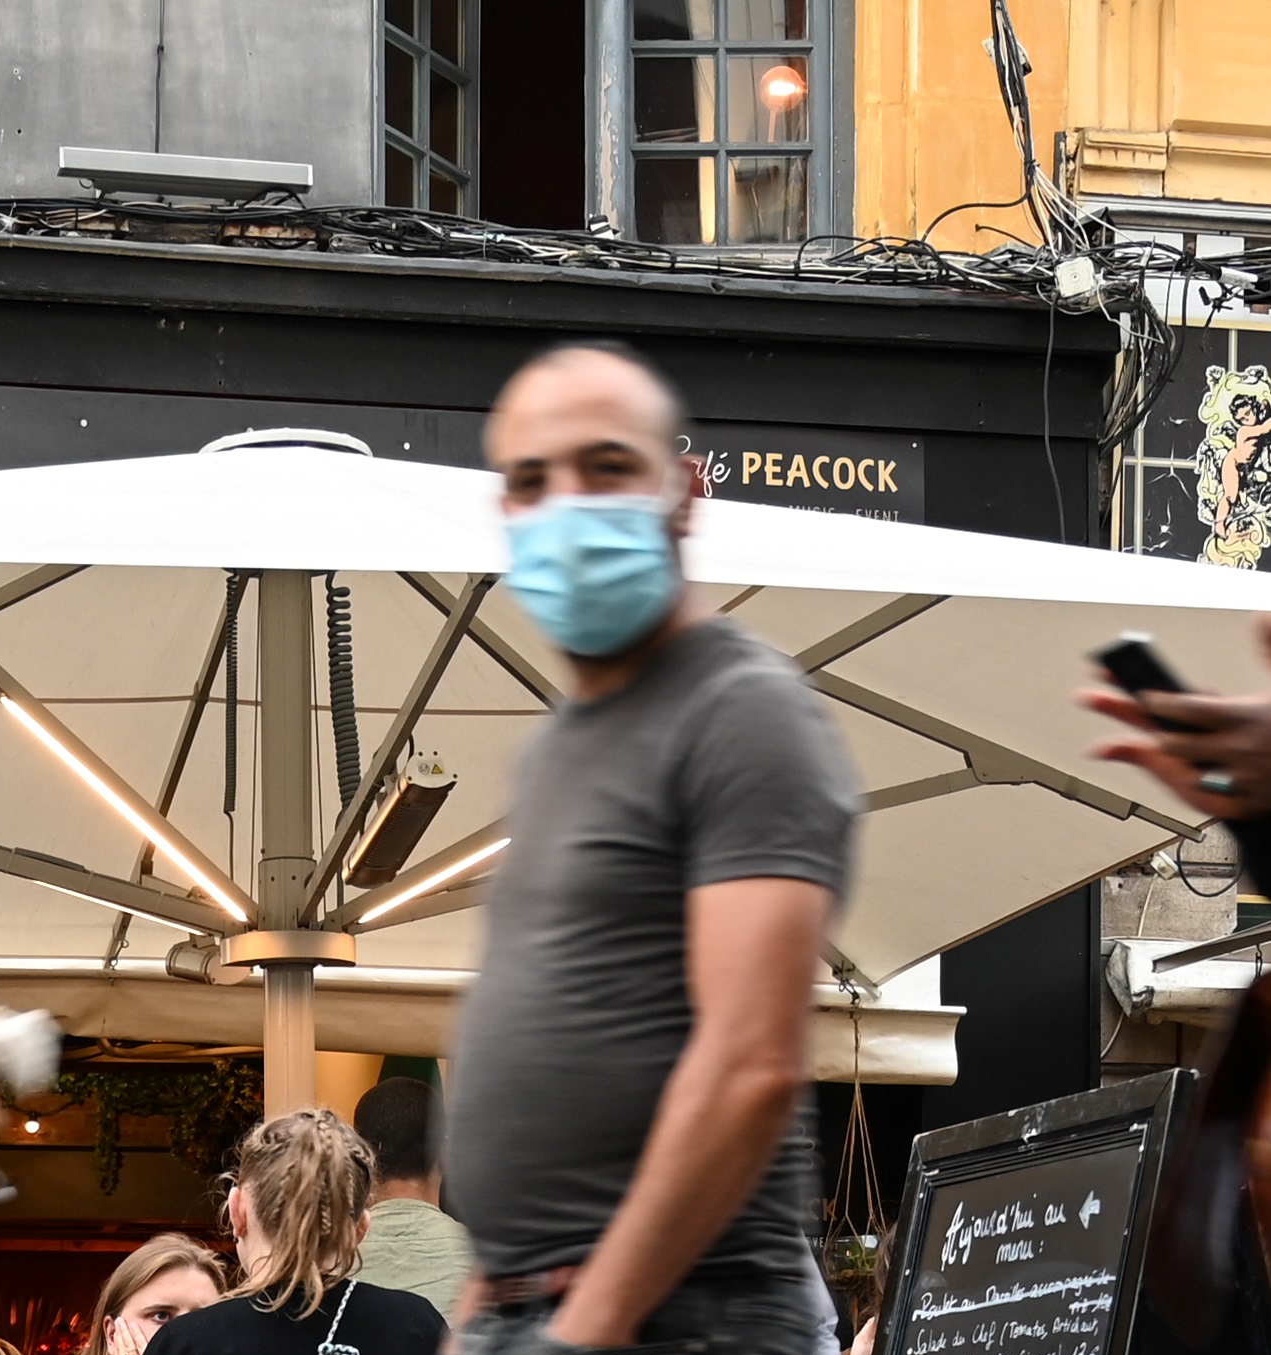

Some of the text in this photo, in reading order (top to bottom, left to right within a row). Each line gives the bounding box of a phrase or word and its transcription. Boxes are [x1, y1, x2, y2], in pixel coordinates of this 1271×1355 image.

[741, 451, 899, 493] PEACOCK
[1044, 1202, 1067, 1227] au
[995, 1239, 1035, 1265] menu
